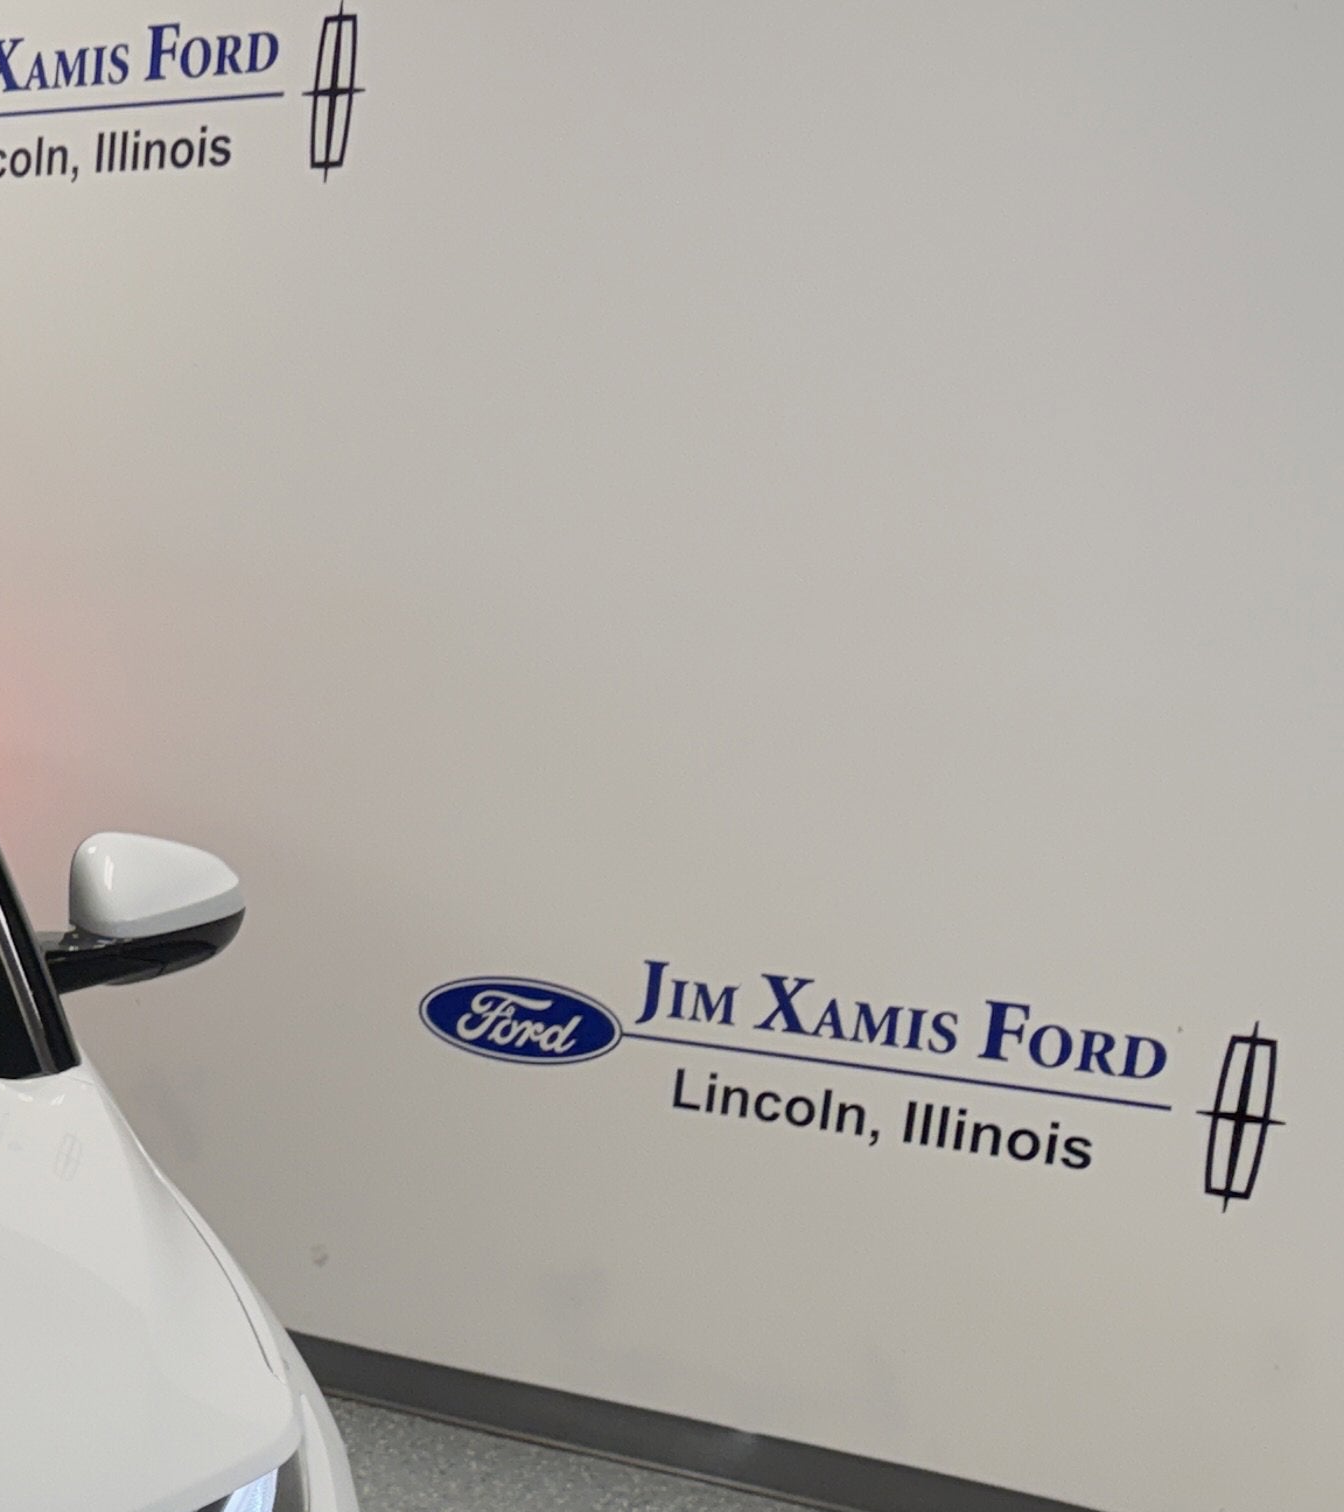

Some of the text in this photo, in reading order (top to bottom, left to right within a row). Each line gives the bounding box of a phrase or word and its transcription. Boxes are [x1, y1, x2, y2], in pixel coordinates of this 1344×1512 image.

[143, 22, 280, 82] FORD
[95, 124, 232, 174] Illinois
[455, 989, 581, 1057] Ford
[634, 959, 1168, 1080] JIM XAMIS FORD
[671, 1067, 1093, 1171] Lincoln, Illinois
